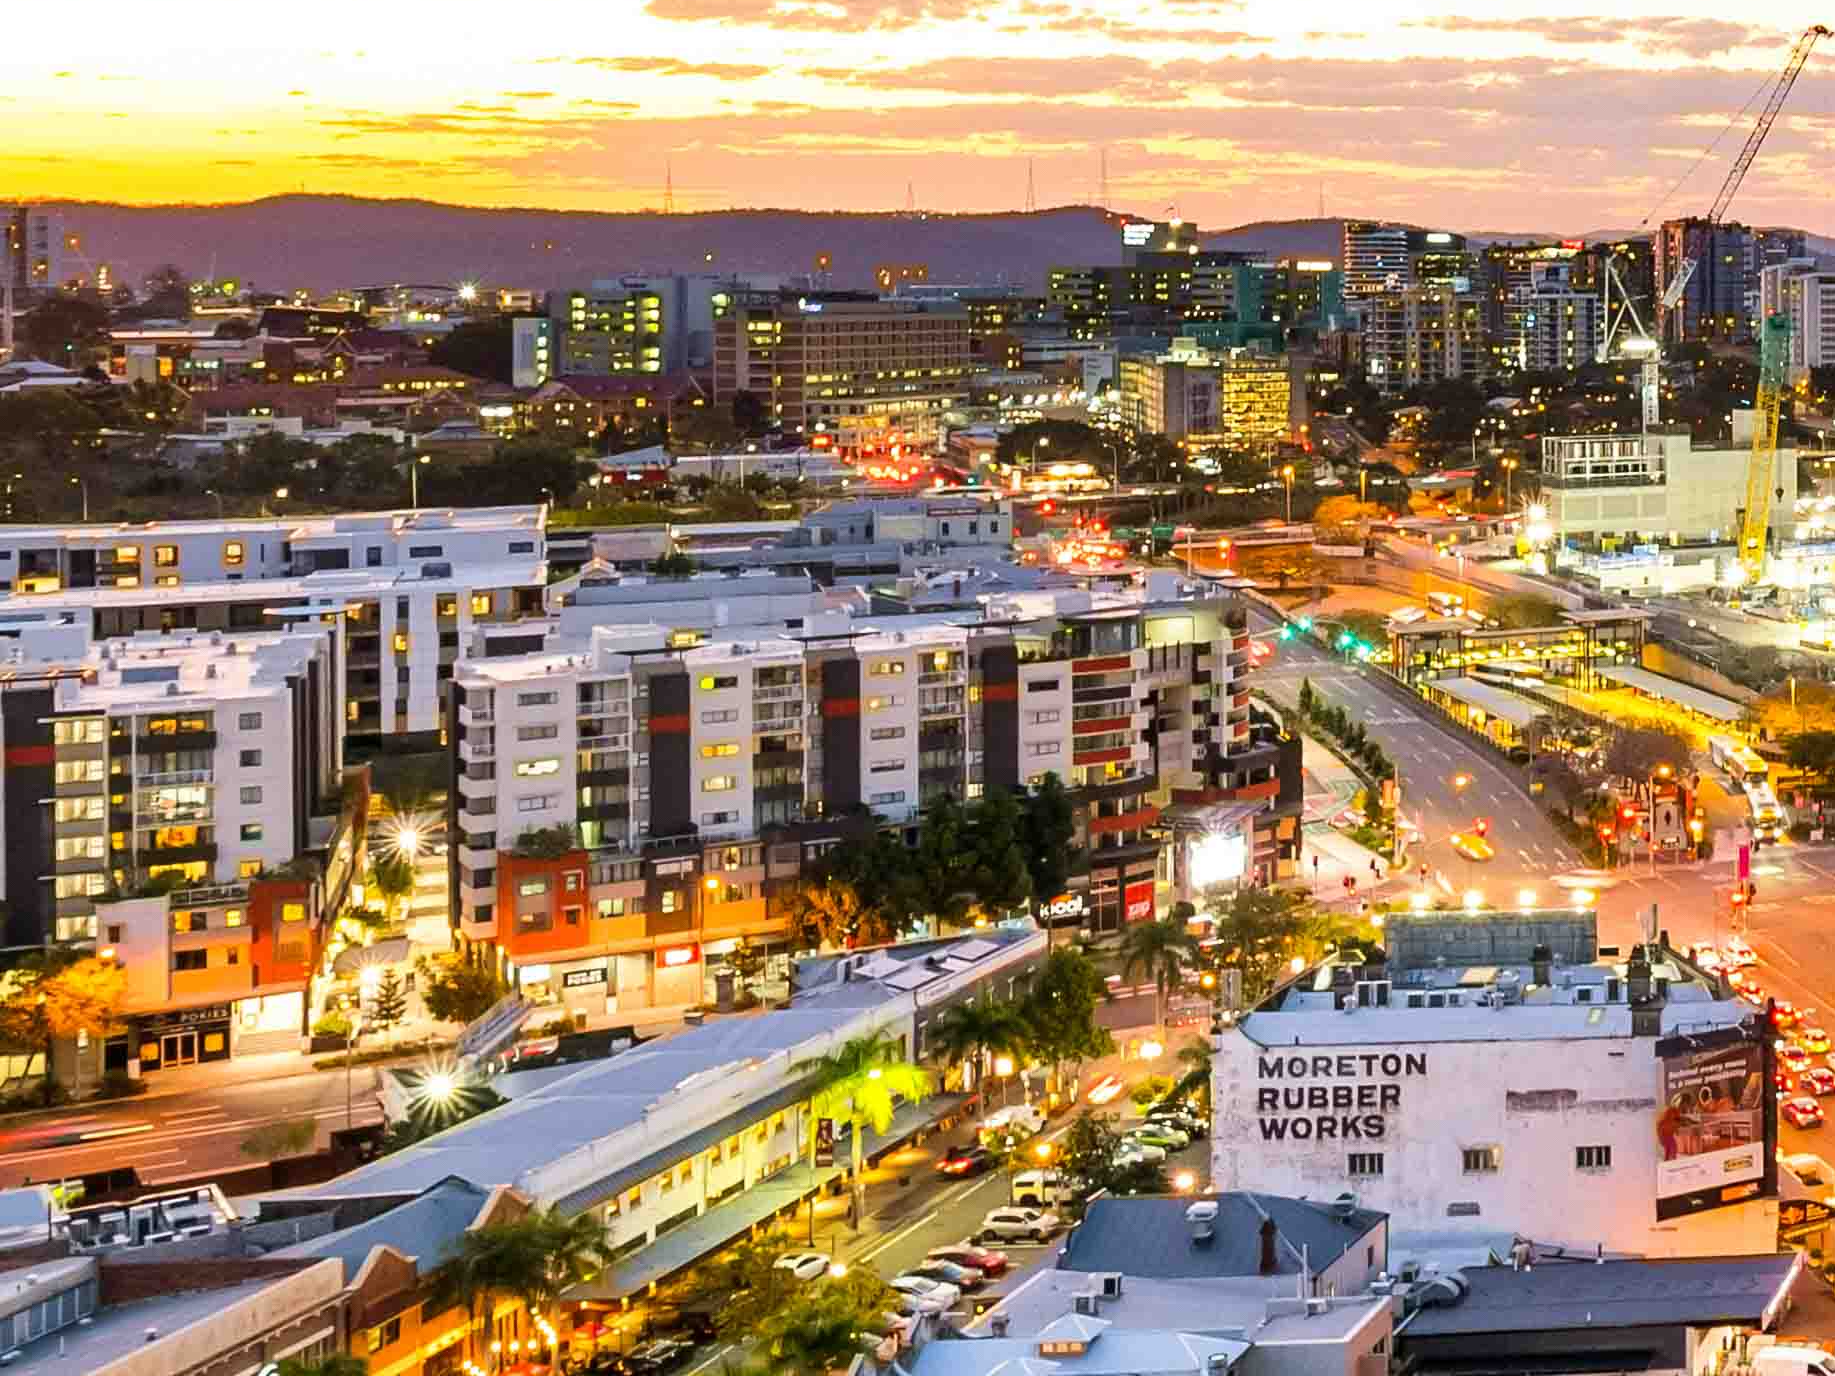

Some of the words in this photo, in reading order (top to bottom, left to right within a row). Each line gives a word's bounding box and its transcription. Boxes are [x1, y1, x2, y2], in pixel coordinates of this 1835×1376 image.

[1257, 1053, 1427, 1079] MORETON
[1257, 1084, 1401, 1111] RUBBER
[1259, 1114, 1385, 1140] WORKS
